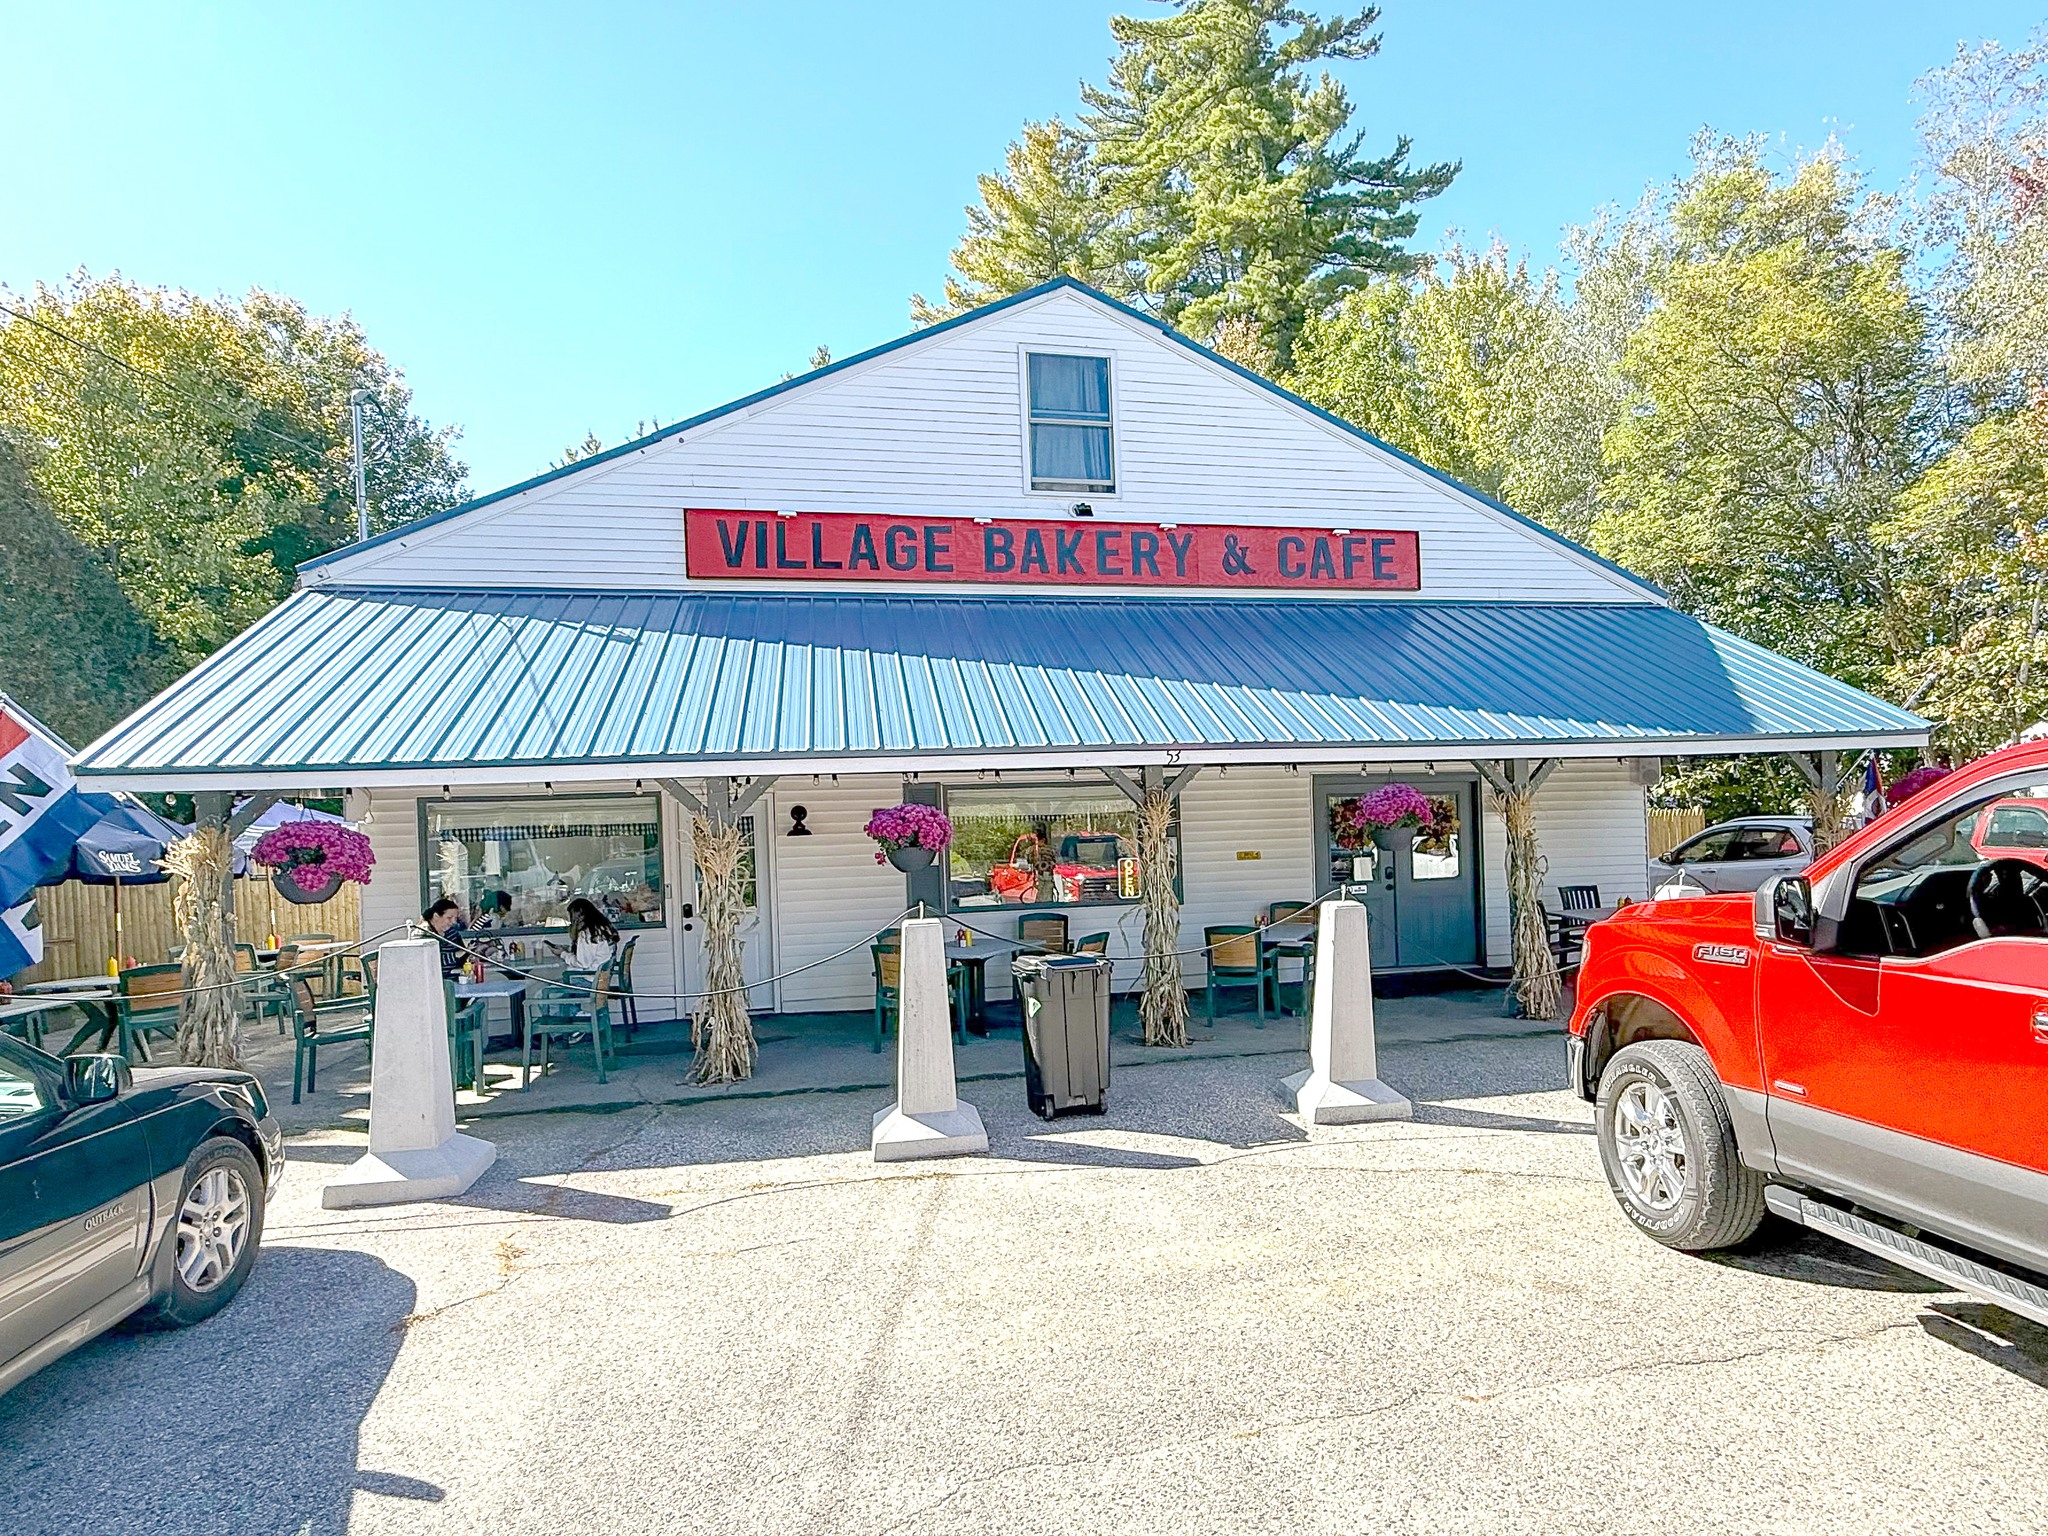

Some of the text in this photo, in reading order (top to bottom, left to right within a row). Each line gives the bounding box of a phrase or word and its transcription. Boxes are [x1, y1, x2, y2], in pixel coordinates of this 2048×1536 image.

[715, 518, 1398, 581] VILLAGE BAKERY & CAFE
[1166, 749, 1182, 765] 53
[98, 850, 141, 864] SAMUEL
[1123, 859, 1135, 897] OPEN
[1604, 1063, 1657, 1091] WRANGLER
[84, 1202, 126, 1231] OUTBACK
[1624, 1201, 1685, 1231] GOODYEAR
